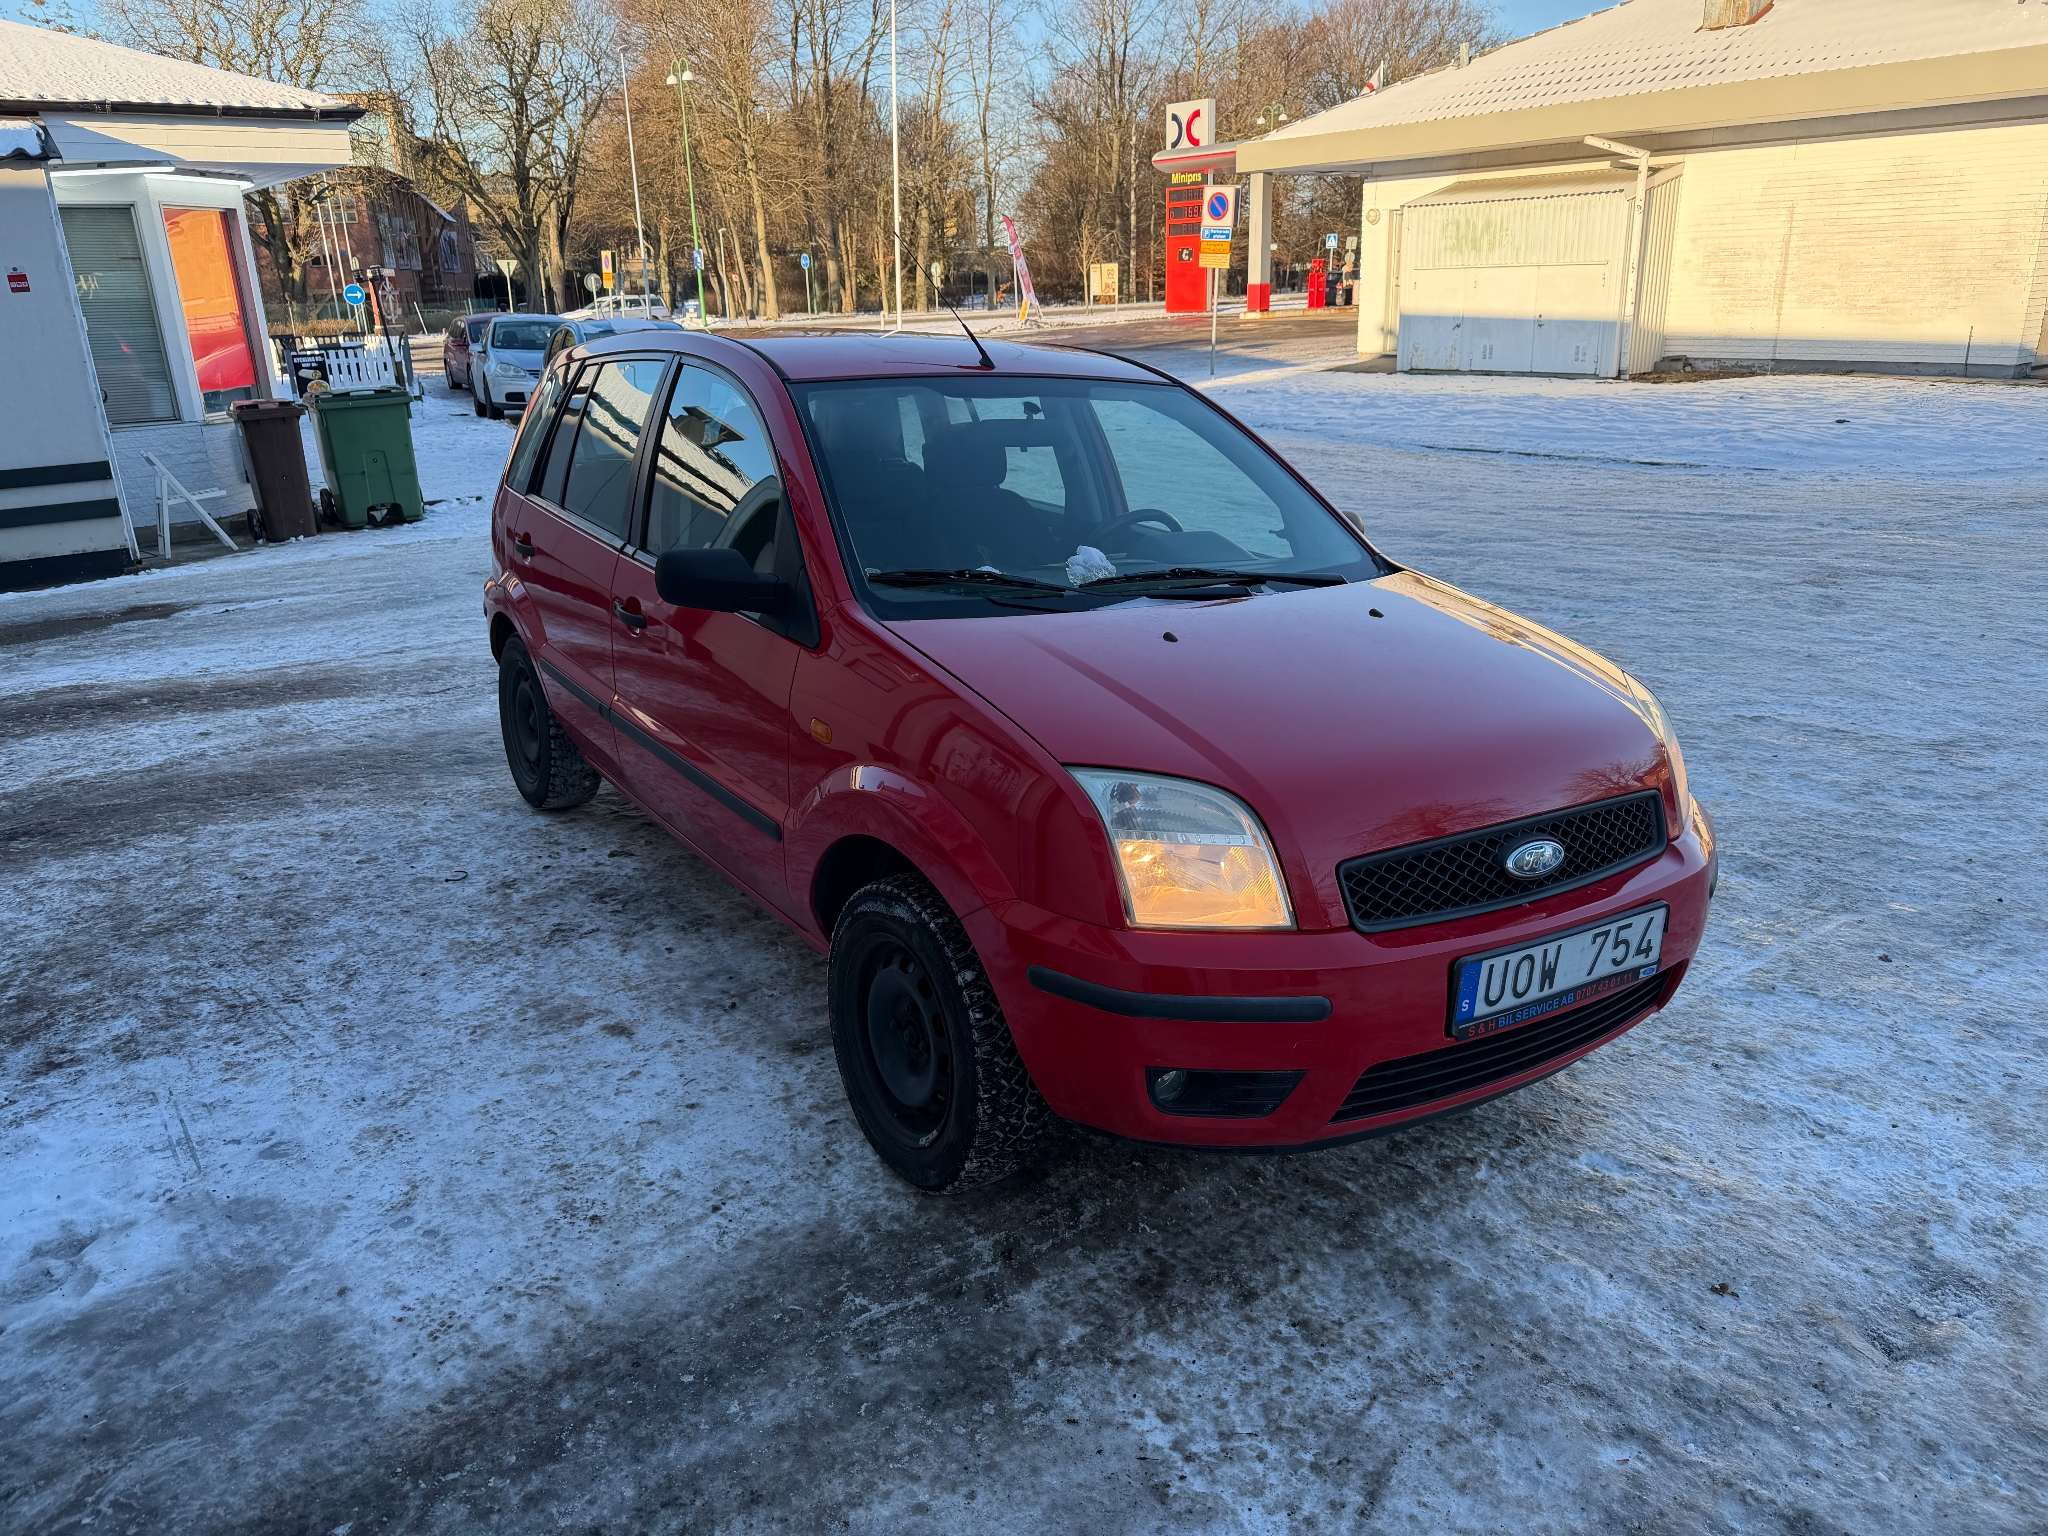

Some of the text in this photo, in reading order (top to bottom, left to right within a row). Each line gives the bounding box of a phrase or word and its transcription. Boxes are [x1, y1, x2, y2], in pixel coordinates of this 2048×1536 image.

[1483, 916, 1655, 1007] UOW 754
[1461, 999, 1470, 1012] S
[1468, 1027, 1475, 1037] S
[1477, 1024, 1486, 1034] &
[1488, 1021, 1496, 1031] H
[1560, 992, 1575, 1007] AB
[1576, 986, 1597, 1001] 0707
[1624, 972, 1633, 984] 11
